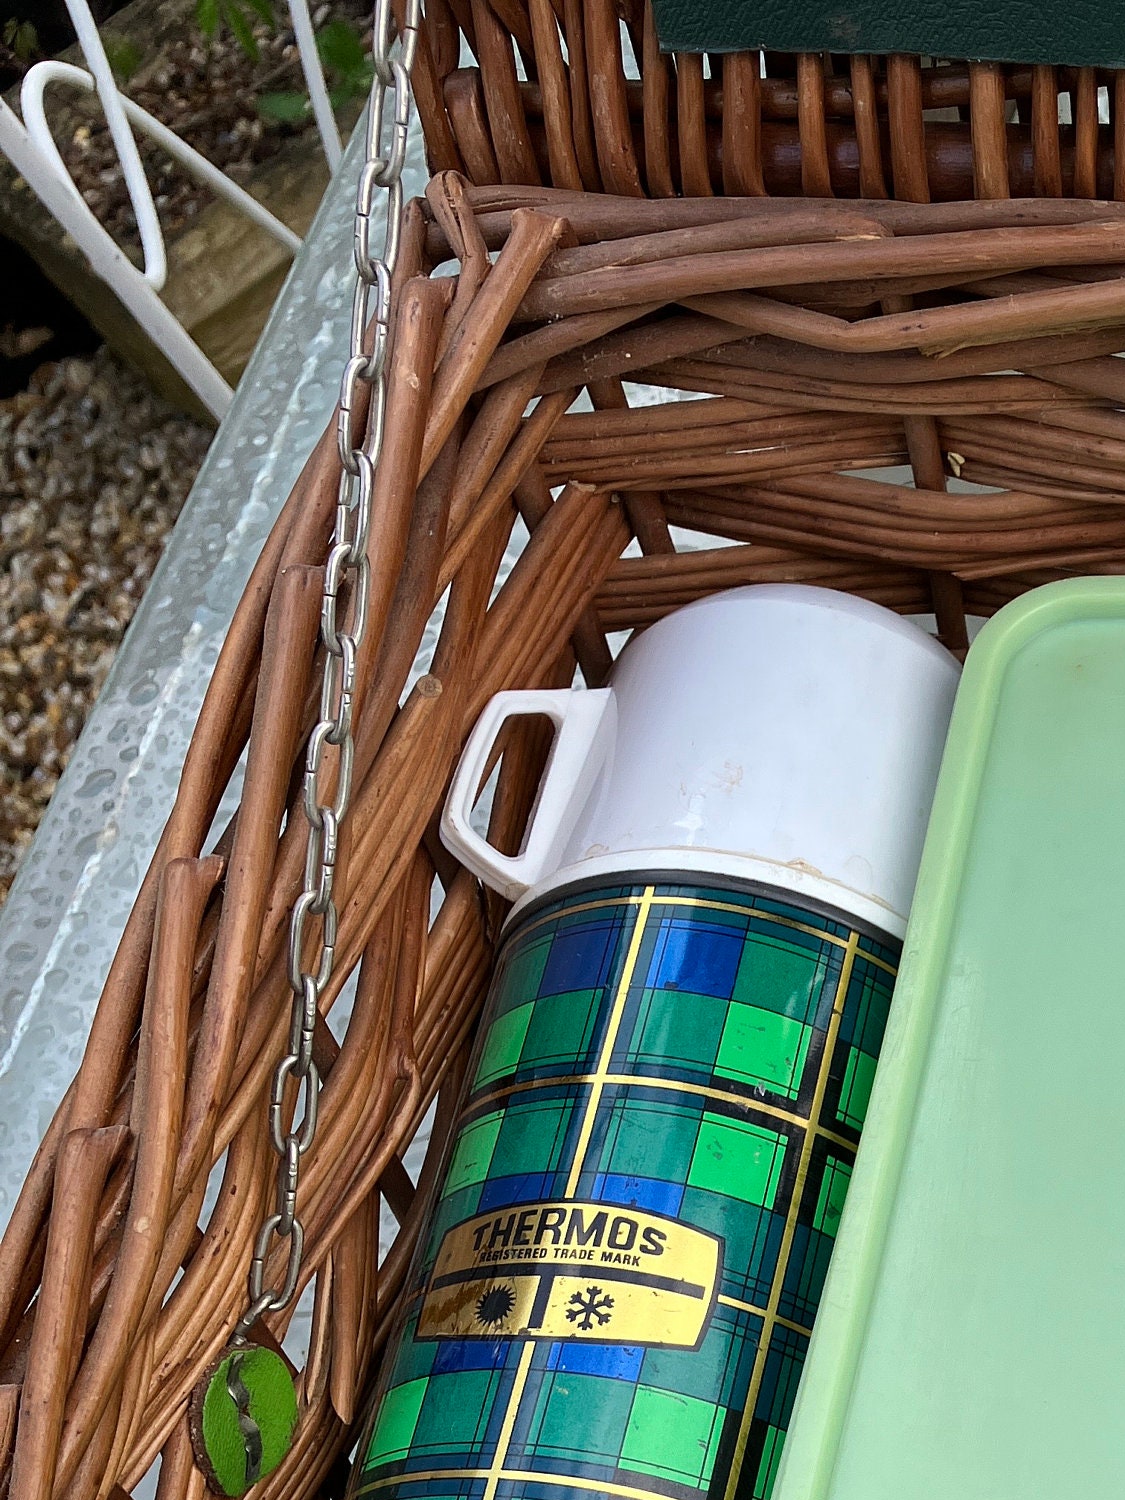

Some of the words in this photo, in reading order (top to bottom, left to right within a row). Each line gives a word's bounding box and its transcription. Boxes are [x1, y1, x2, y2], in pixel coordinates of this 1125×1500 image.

[472, 1207, 667, 1256] THERMOS
[479, 1247, 547, 1263] REGISTERED
[553, 1247, 594, 1260] TRADE
[600, 1251, 642, 1267] MARK
